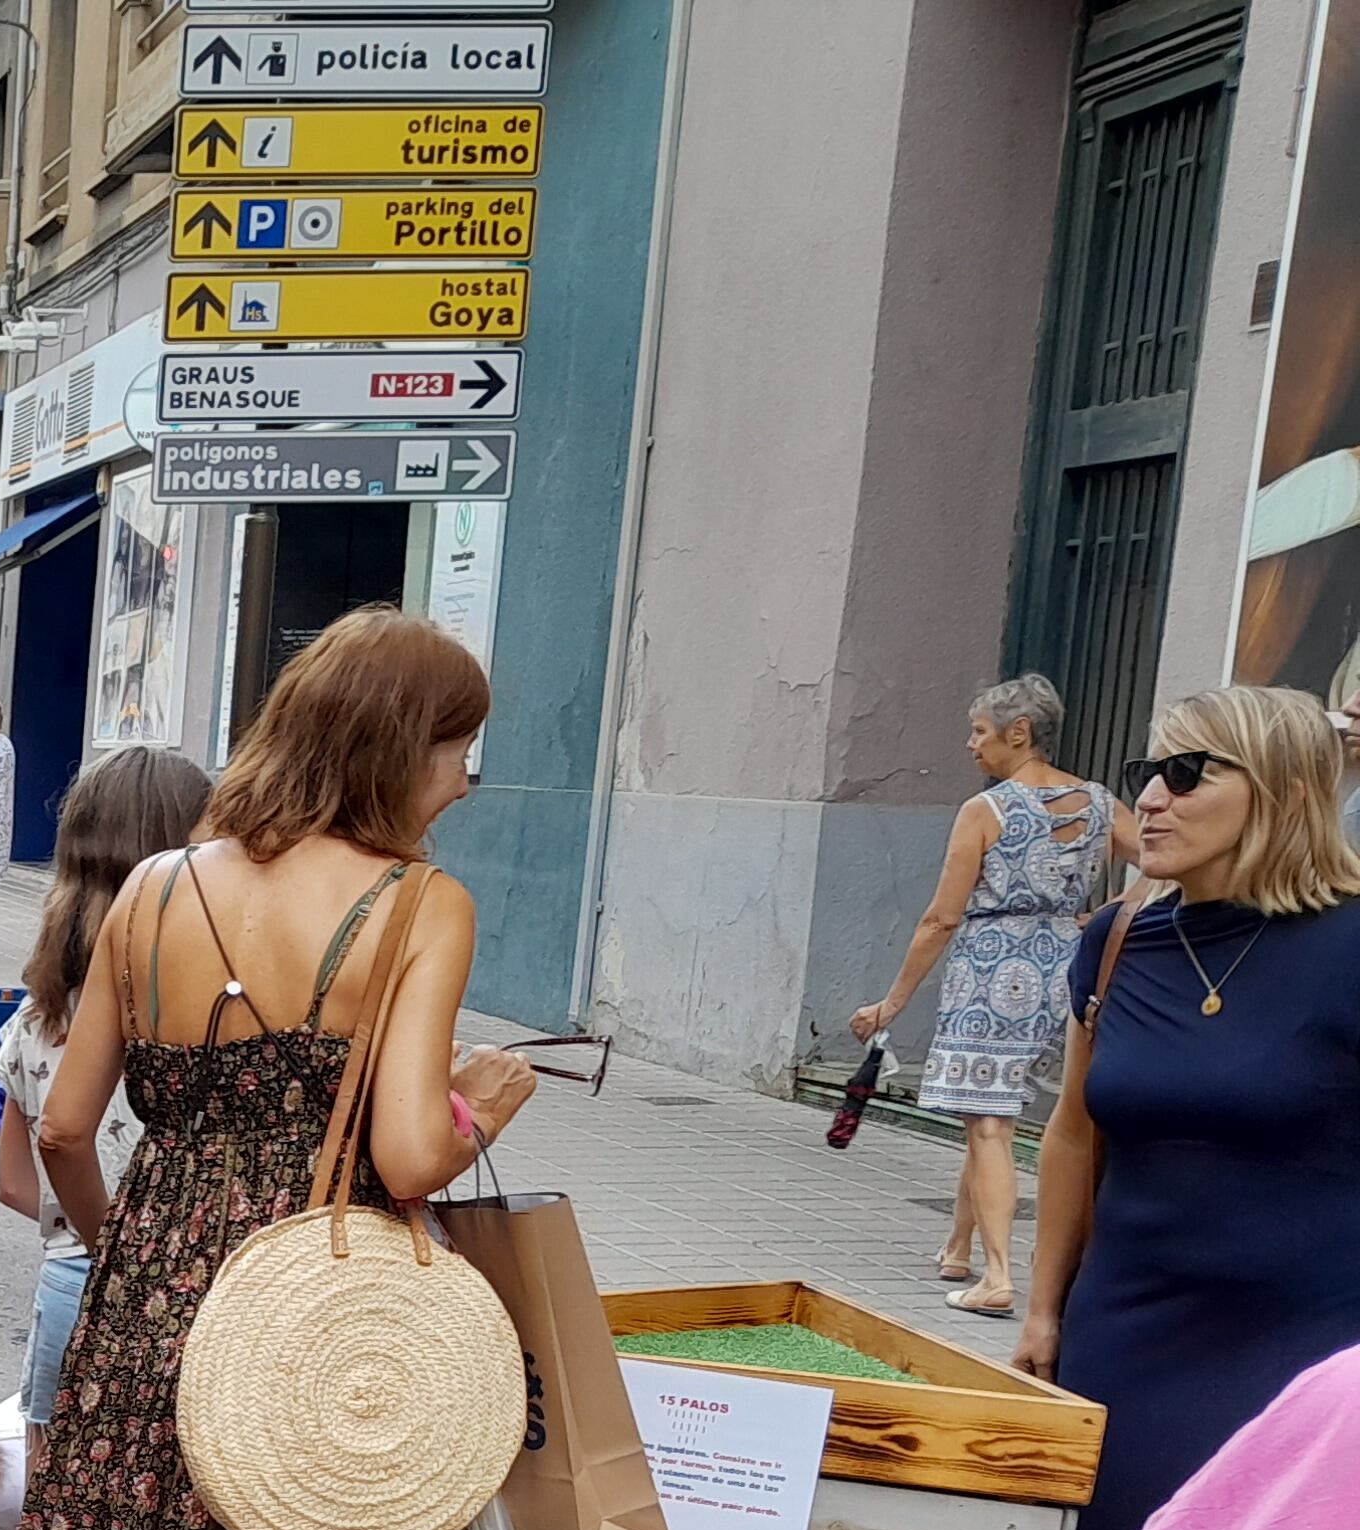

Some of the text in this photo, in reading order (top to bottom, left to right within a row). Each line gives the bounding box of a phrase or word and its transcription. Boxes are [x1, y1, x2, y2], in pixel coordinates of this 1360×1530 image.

[316, 42, 536, 76] policía local
[407, 115, 531, 134] oficina de
[401, 138, 529, 164] turismo
[385, 197, 525, 220] parking del
[393, 220, 523, 246] Portillo
[441, 278, 517, 296] hostal
[429, 301, 514, 331] Goya
[171, 366, 255, 385] GRAUS
[377, 375, 445, 395] N-123
[169, 390, 300, 409] BENASQUE
[165, 441, 278, 464] polígonos
[162, 463, 362, 491] industriales
[658, 1394, 730, 1414] 15 PALOS
